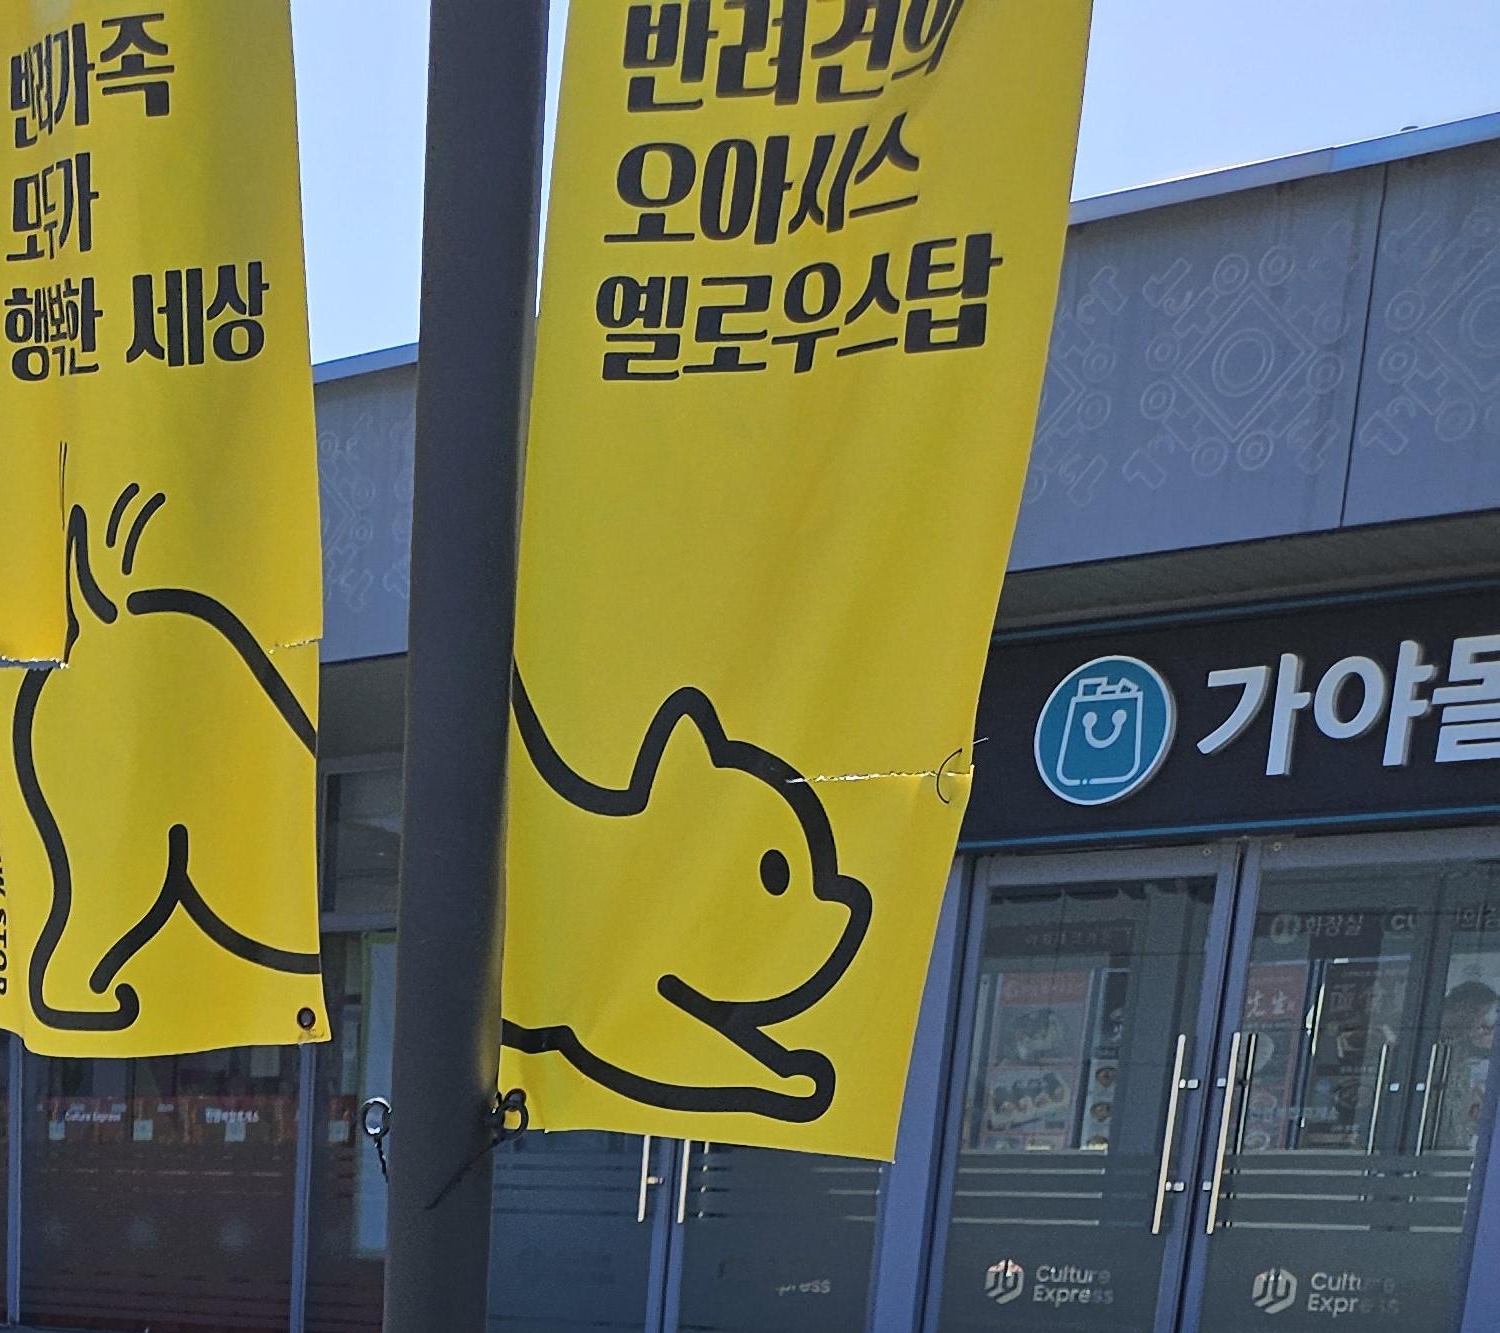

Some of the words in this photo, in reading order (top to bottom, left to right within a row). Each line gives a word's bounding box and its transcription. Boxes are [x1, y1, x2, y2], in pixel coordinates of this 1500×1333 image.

[604, 112, 920, 245] 오아시스
[126, 261, 269, 367] 세상
[595, 232, 1003, 381] 옐로우스탑
[1035, 1264, 1112, 1285] Culture
